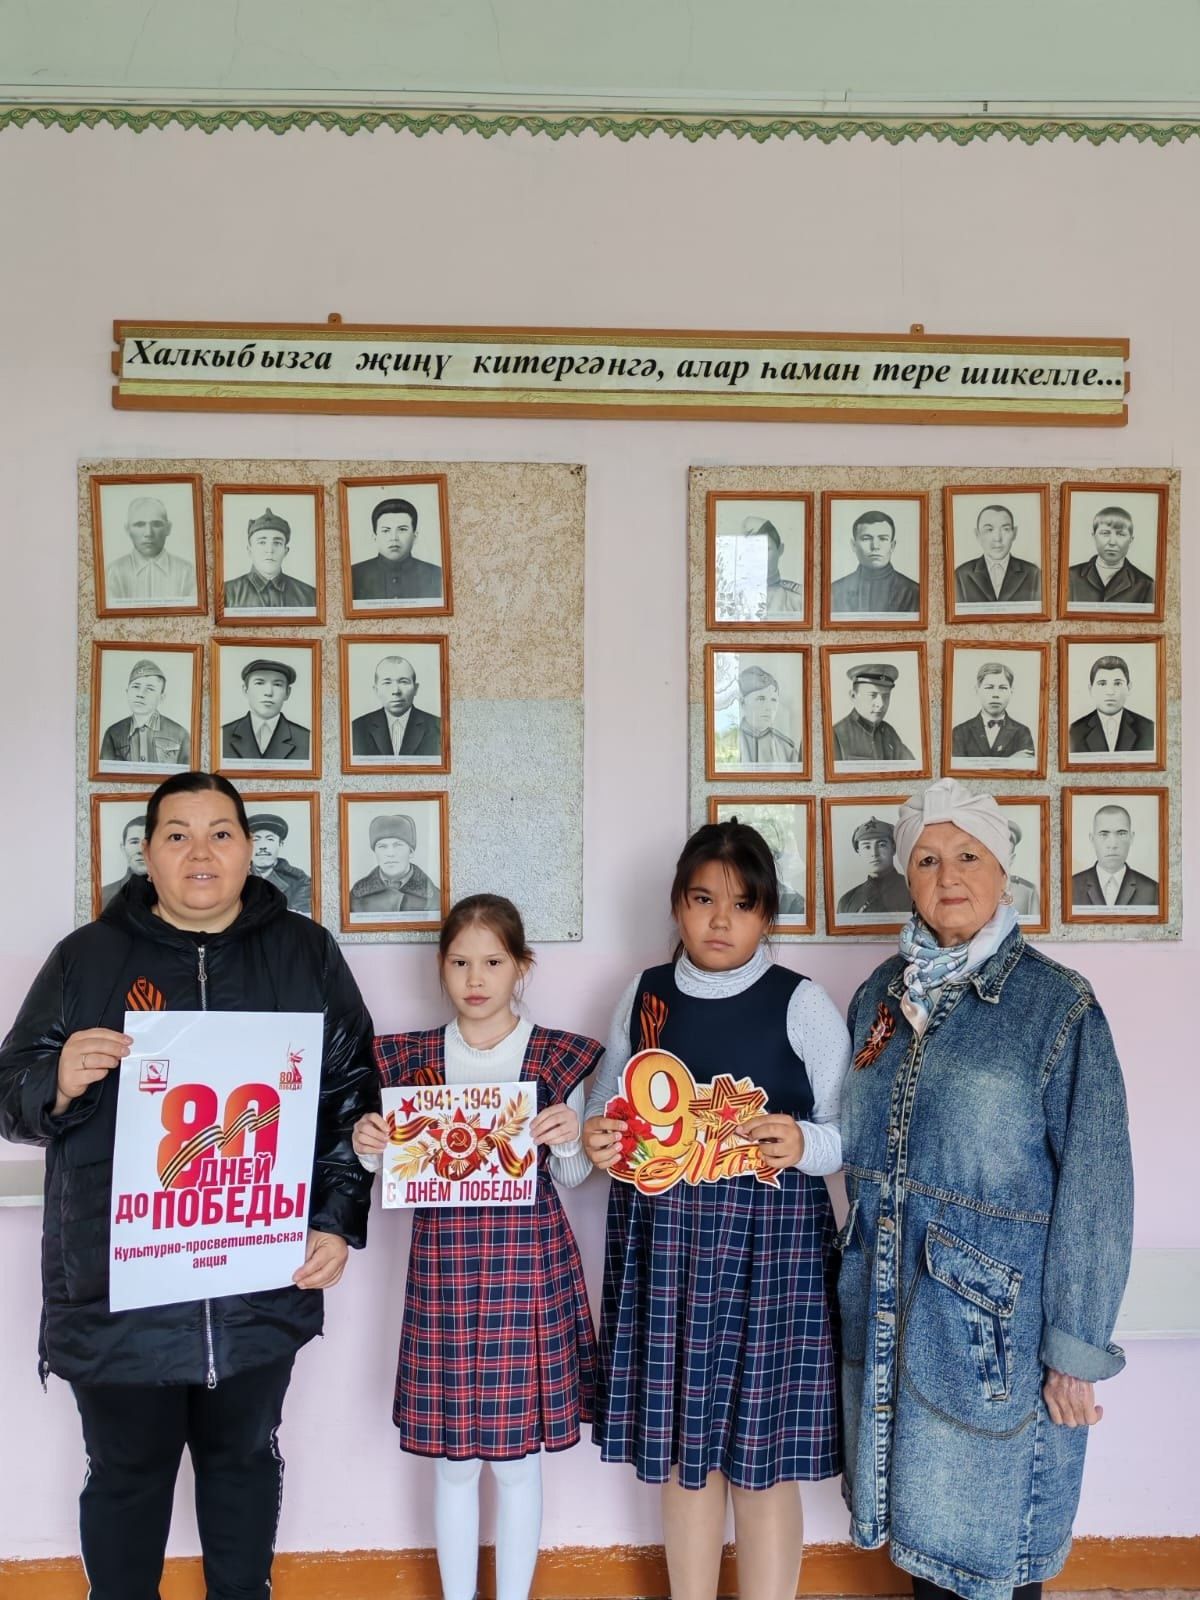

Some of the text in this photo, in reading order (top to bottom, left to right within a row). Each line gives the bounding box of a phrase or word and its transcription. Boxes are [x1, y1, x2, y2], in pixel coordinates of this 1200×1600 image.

[126, 339, 1122, 388] Халкыбызга җиңү китергәнгә, алар һаман тере шикелле...
[415, 1087, 502, 1111] 1941-1945
[625, 1051, 697, 1160] 9
[157, 1083, 281, 1190] 80
[200, 1152, 272, 1191] ДНЕЙ
[386, 1178, 533, 1203] С ДНЁМ ПОБЕДЫ!
[115, 1183, 307, 1230] ДО ПОБЕДЫ
[114, 1231, 304, 1261] Культурно-просветительская
[192, 1253, 228, 1269] акция
